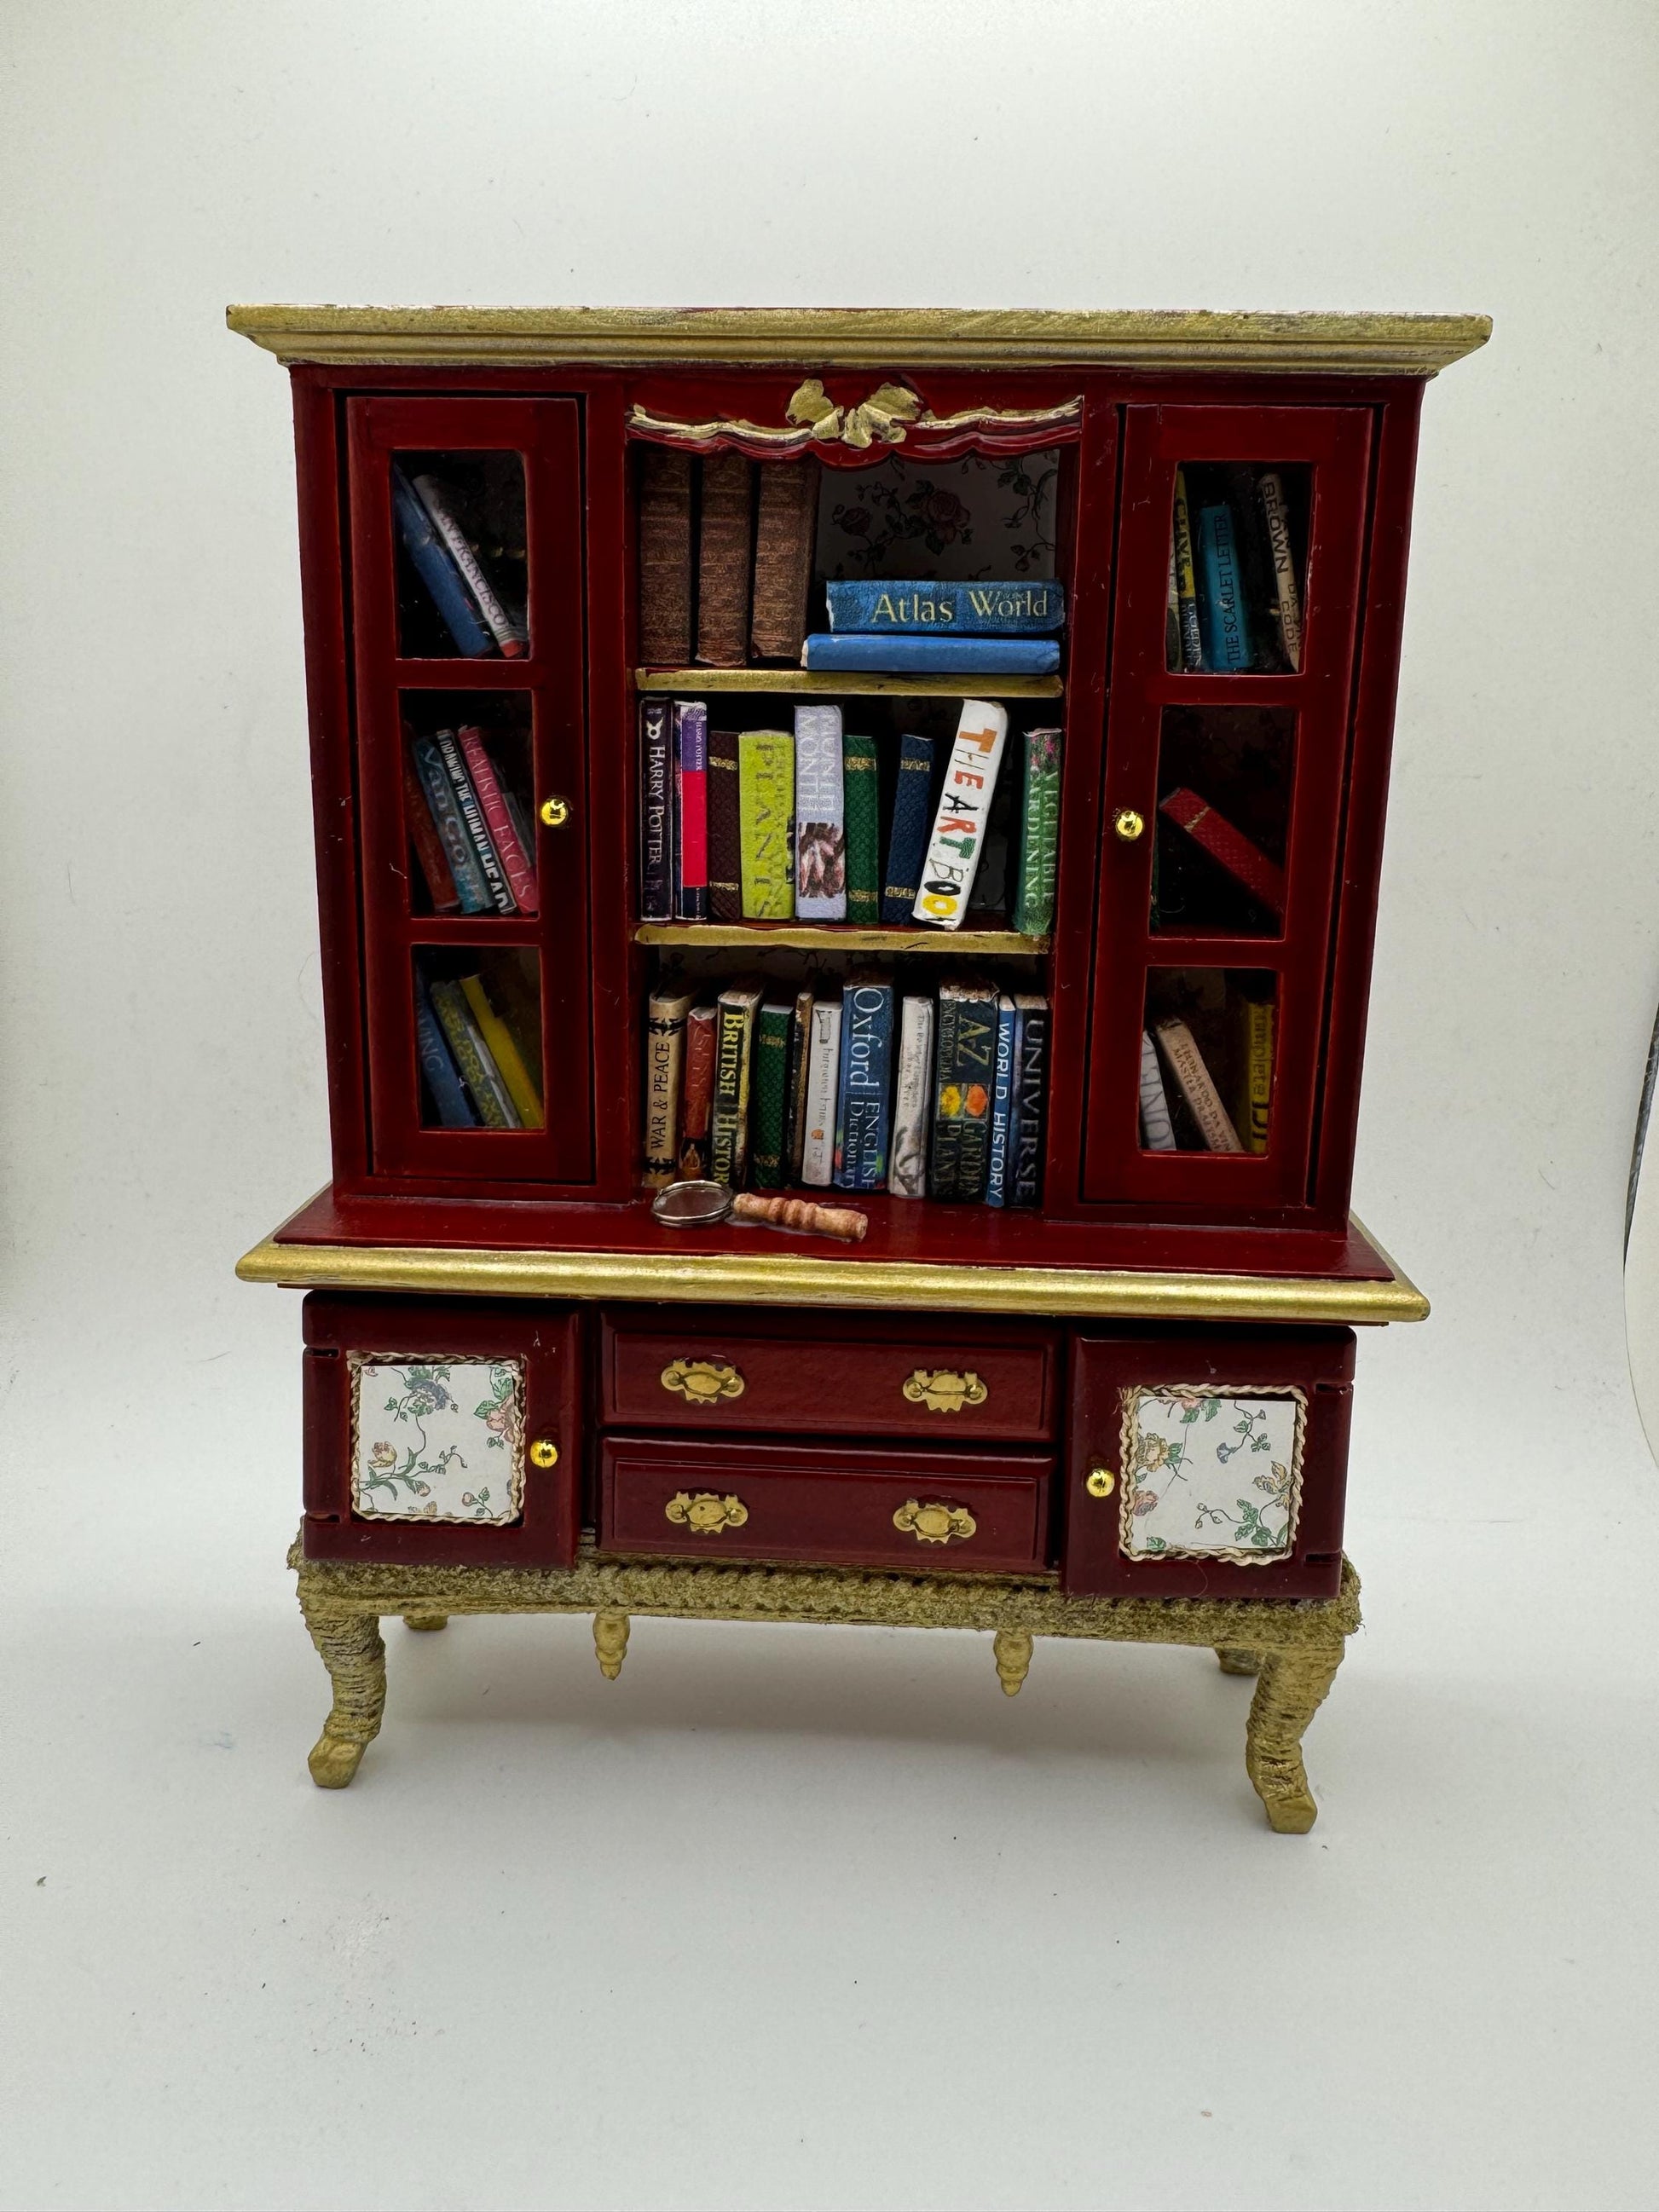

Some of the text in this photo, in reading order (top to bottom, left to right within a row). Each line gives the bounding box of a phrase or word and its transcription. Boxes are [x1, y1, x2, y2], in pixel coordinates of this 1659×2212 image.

[1263, 482, 1289, 575] BROWN
[454, 537, 507, 626] FRANCISCO
[871, 588, 1049, 625] Atlas World
[1214, 513, 1241, 664] THE SCARLET LETTER
[1281, 601, 1298, 653] CODE
[425, 747, 449, 809] Van
[649, 745, 666, 800] HARRY
[799, 713, 819, 812] MONTH
[463, 735, 531, 898] REALISTIC FACES
[646, 805, 665, 866] POTTER
[921, 728, 998, 923] THE ART BOO
[1023, 765, 1042, 909] GARDENING
[1043, 770, 1059, 898] VEGETABLE
[850, 986, 884, 1087] Oxford
[650, 1042, 670, 1150] WAR & PEACE
[714, 1011, 745, 1185] BRITISH HISTOR
[845, 1101, 864, 1189] Dictionary
[860, 1100, 881, 1189] ENGLISH
[988, 1022, 1010, 1198] WORLD HISTORY
[1015, 1019, 1045, 1196] UNIVERSE
[960, 1121, 987, 1193] GARDEN
